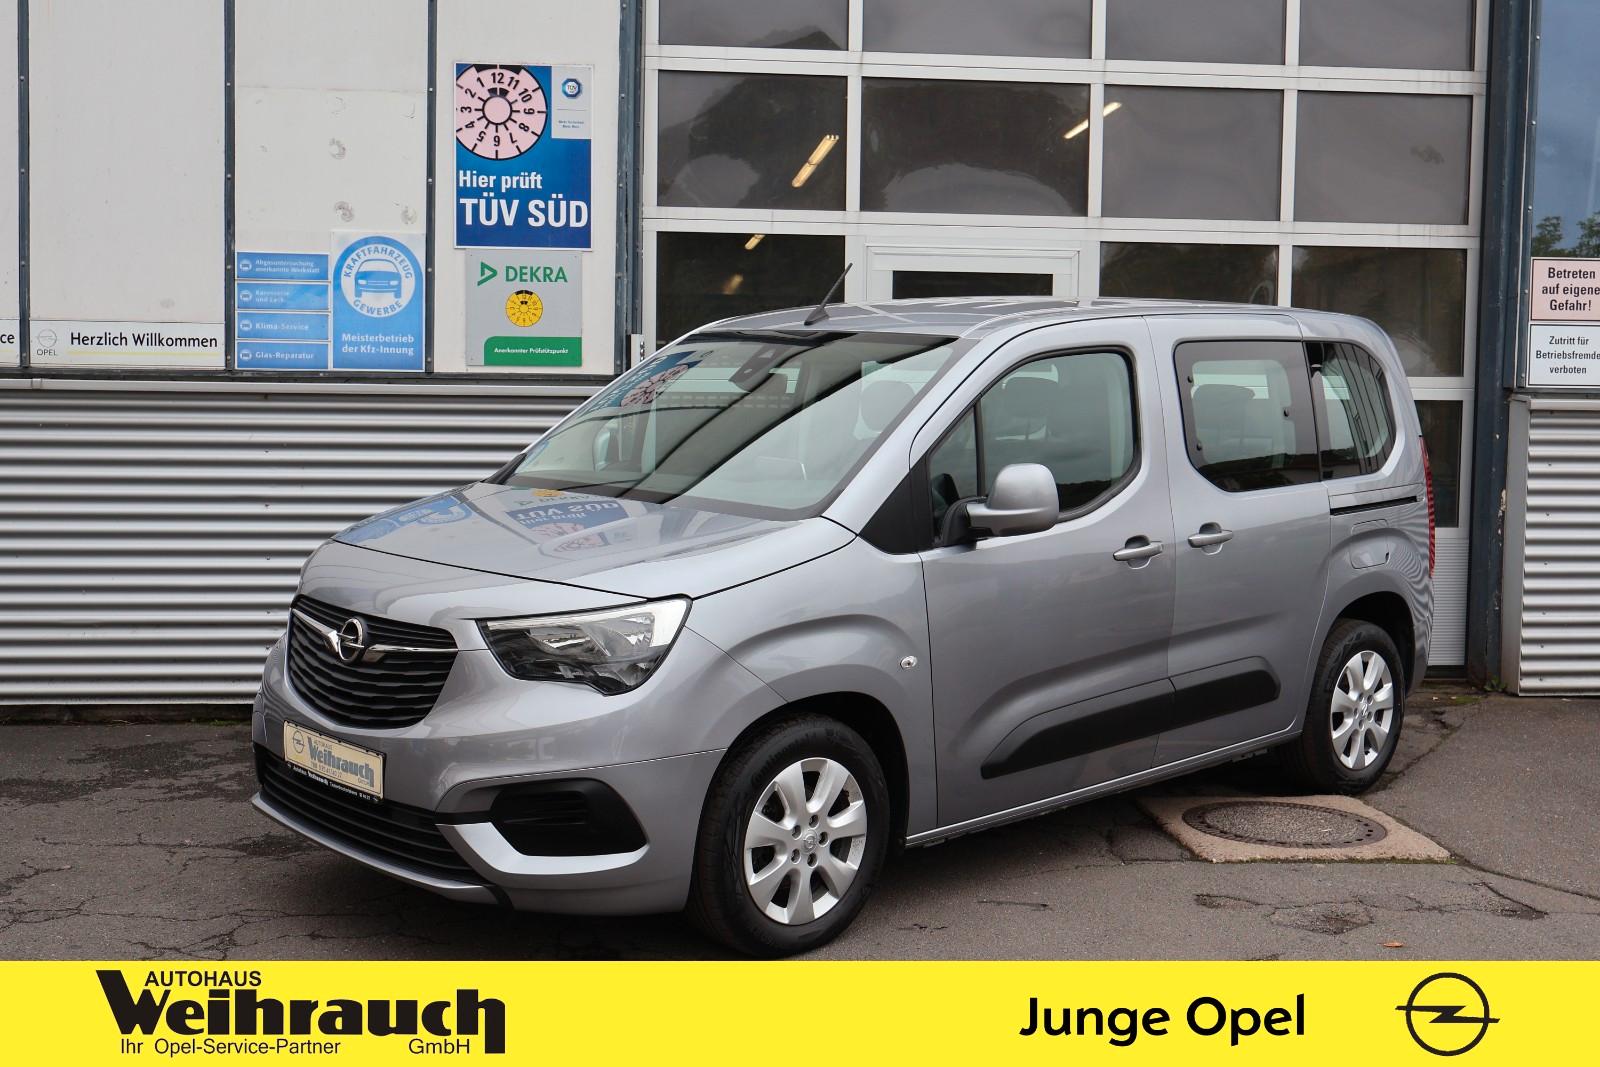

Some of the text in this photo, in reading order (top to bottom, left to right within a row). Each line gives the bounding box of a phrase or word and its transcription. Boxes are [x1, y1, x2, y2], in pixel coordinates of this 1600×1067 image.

[476, 77, 485, 87] 1
[491, 72, 504, 84] 12
[507, 76, 520, 90] 11
[465, 88, 476, 98] 2
[518, 88, 532, 103] 10
[524, 107, 535, 115] 9
[465, 121, 475, 130] 4
[518, 122, 530, 132] 8
[476, 131, 486, 142] 5
[494, 135, 500, 146] 6
[509, 132, 517, 144] 7
[459, 170, 543, 192] Hier prüft
[459, 191, 588, 228] TÜV SÜD
[343, 246, 413, 279] KRAFTFAHRZEUG
[505, 265, 568, 283] DEKRA
[1548, 267, 1596, 279] Betreten
[1542, 284, 1600, 297] auf eigene
[353, 298, 403, 316] GEWERBE
[1550, 299, 1592, 311] Gefahr!
[255, 323, 309, 331] Klima-Service
[70, 332, 218, 348] Herzlich Willkommen
[342, 333, 415, 343] Meisterbetrieb
[1549, 336, 1590, 345] Zutritt für
[255, 351, 315, 360] Glas-Reparatur
[342, 345, 414, 356] der Kfz-Innung
[529, 347, 569, 355] Prüfstützpunkt
[1535, 350, 1600, 360] Betriebsfremde
[1549, 365, 1587, 374] verboten
[307, 736, 375, 788] Weihrauch
